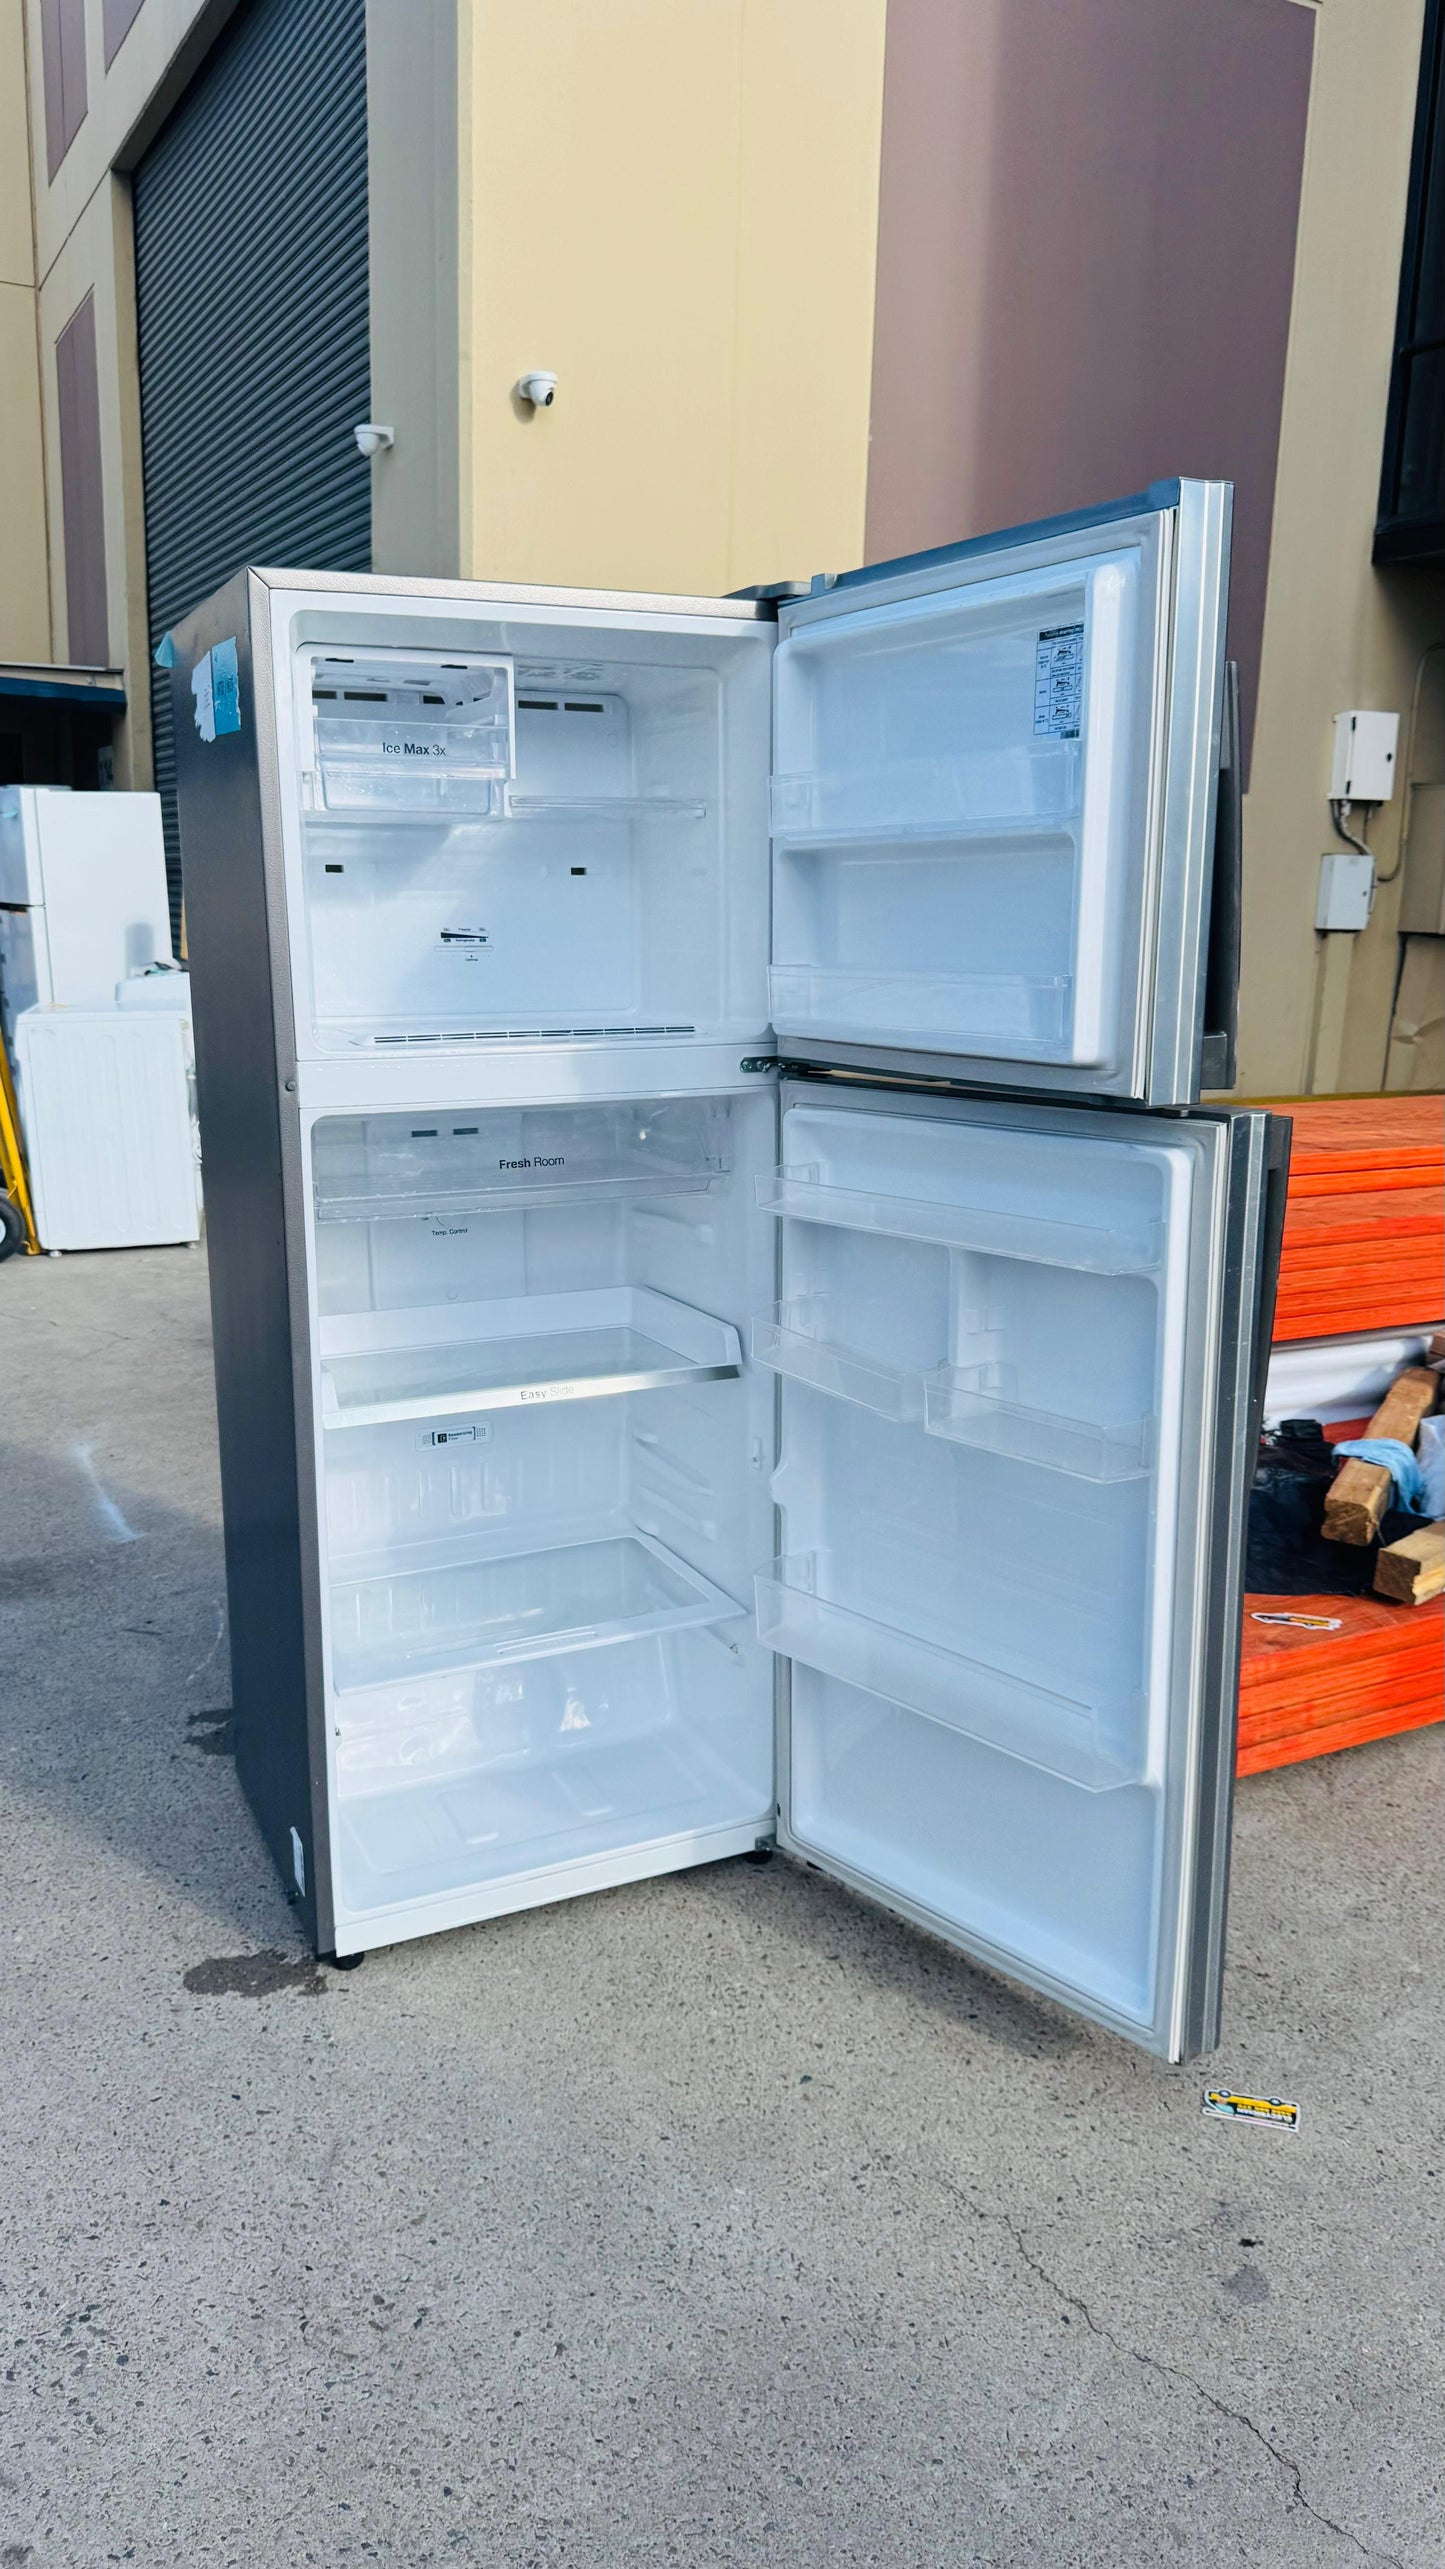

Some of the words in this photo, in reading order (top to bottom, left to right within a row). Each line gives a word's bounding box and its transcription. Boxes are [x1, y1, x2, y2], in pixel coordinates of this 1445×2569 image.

[382, 742, 401, 754] Ice
[404, 743, 430, 755] Max
[432, 744, 447, 756] 3x
[499, 1158, 531, 1170] Fresh
[534, 1156, 565, 1167] Room
[520, 1390, 547, 1401] Easy
